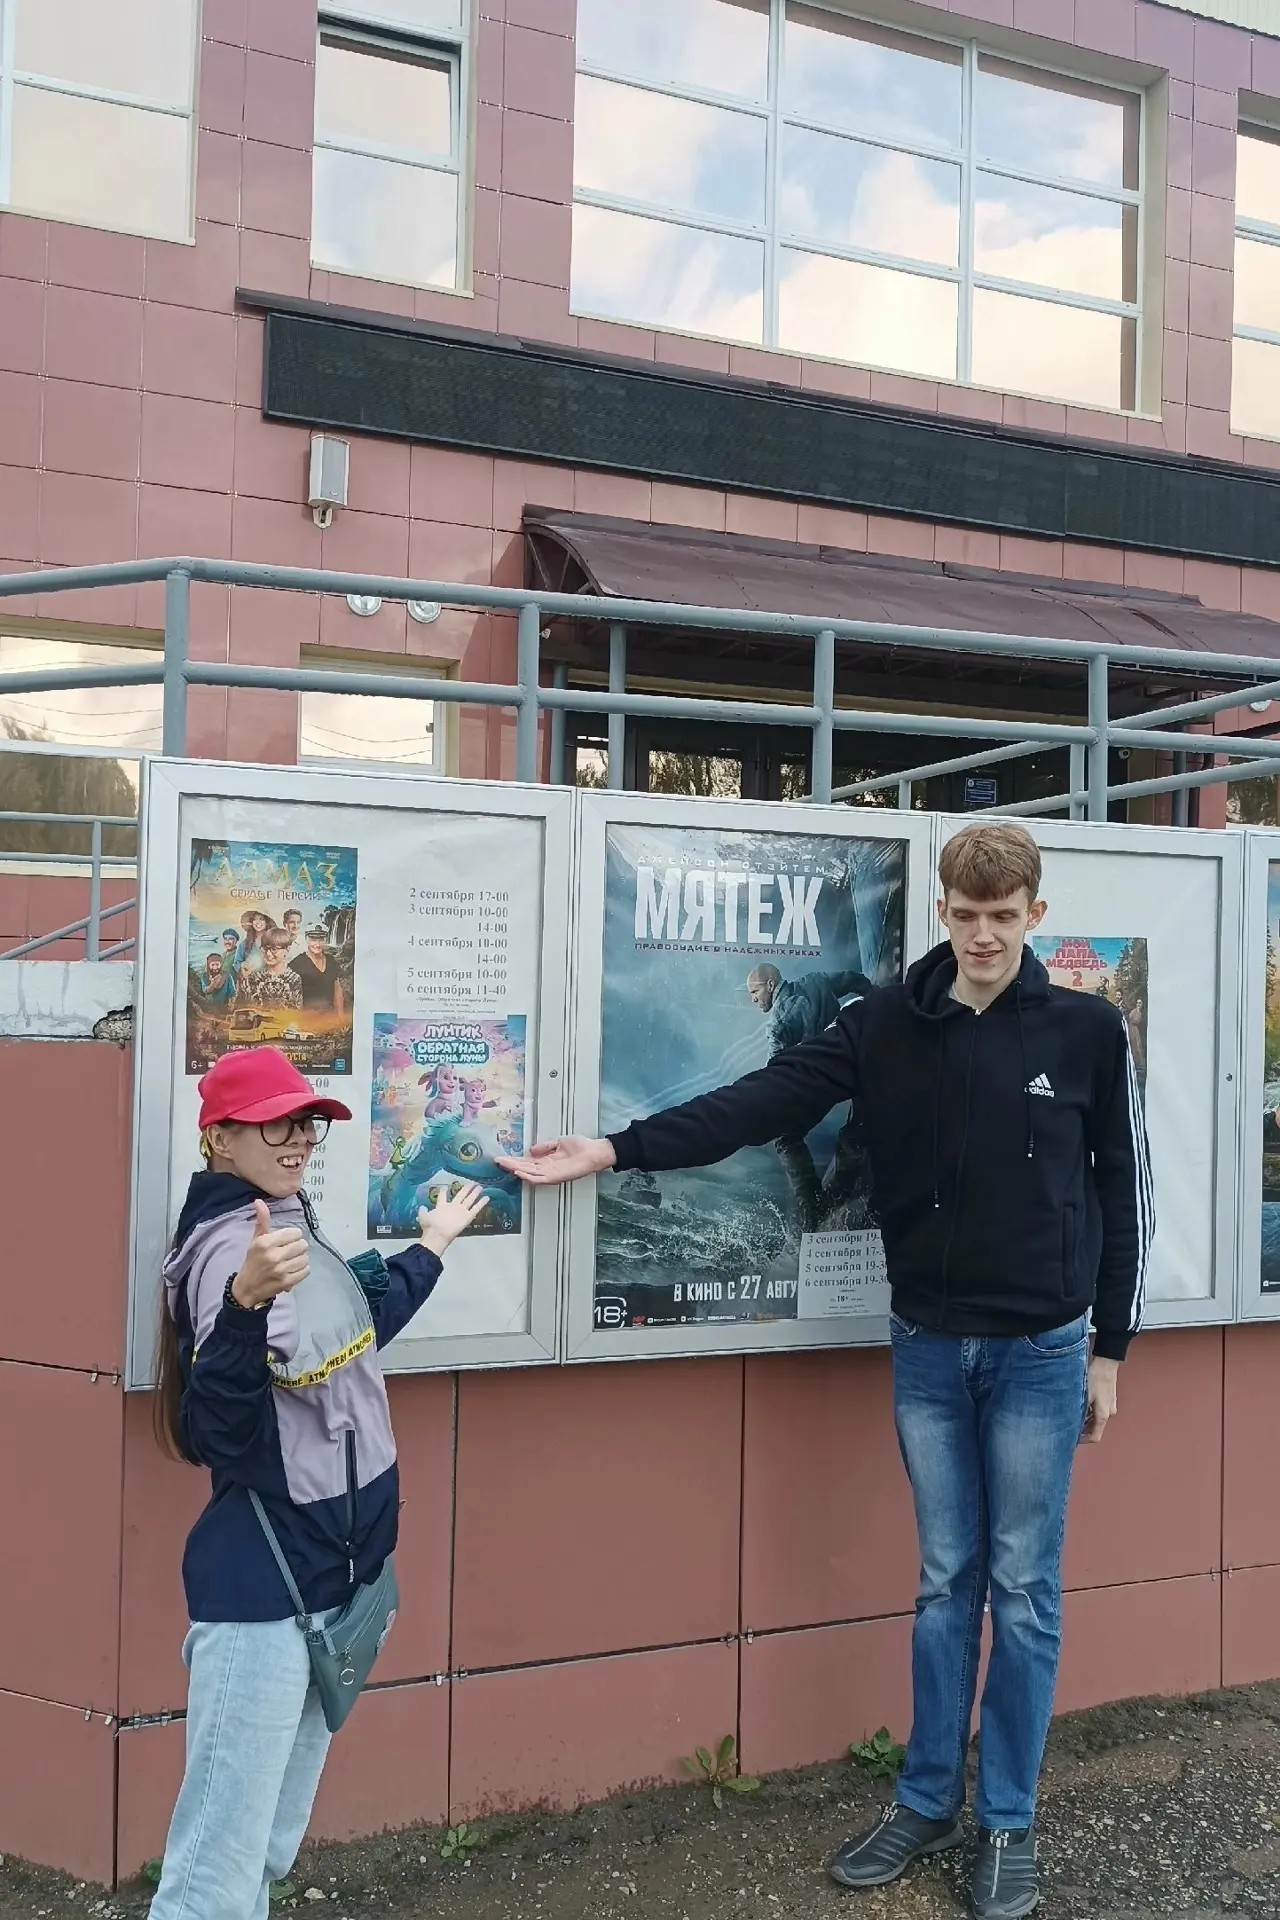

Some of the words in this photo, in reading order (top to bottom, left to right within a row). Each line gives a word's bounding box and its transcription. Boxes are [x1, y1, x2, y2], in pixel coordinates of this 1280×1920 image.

[213, 857, 339, 891] АЛМАЗ
[409, 887, 416, 898] 2
[419, 890, 474, 903] сентября
[479, 891, 509, 902] 17-00
[408, 903, 416, 914] 3
[419, 905, 474, 919] сентября
[479, 906, 509, 918] 10-00
[635, 866, 825, 947] МЯТЕЖ
[478, 922, 508, 933] 14-00
[407, 935, 415, 946] 4
[418, 937, 473, 950] сентября
[478, 938, 508, 949] 10-00
[477, 953, 507, 964] 14-00
[1046, 958, 1108, 971] МЕДВЕДЬ
[407, 967, 414, 978] 5
[417, 968, 472, 981] сентября
[477, 969, 507, 980] 10-00
[1071, 970, 1083, 987] 2
[406, 983, 414, 994] 6
[417, 984, 471, 997] сентября
[424, 1023, 483, 1039] ЛУНТИК
[417, 1042, 486, 1054] ОБРАТНАЯ
[190, 1060, 203, 1070] 6+
[416, 1054, 459, 1063] СТОРОНА
[459, 1054, 487, 1063] ЛУНЫ
[807, 1235, 814, 1245] 3
[815, 1233, 862, 1245] сентября
[865, 1232, 881, 1242] 19-
[806, 1249, 813, 1259] 4
[814, 1247, 862, 1259] сентября
[865, 1246, 885, 1256] 17-3
[805, 1263, 812, 1273] 5
[814, 1261, 862, 1274] сентября
[673, 1284, 682, 1302] В
[686, 1281, 722, 1301] КИНО
[727, 1281, 737, 1300] С
[740, 1275, 762, 1300] 27
[765, 1279, 798, 1299] АВГУ
[804, 1277, 811, 1288] 6
[813, 1276, 861, 1288] сентября
[594, 1305, 628, 1324] 18+
